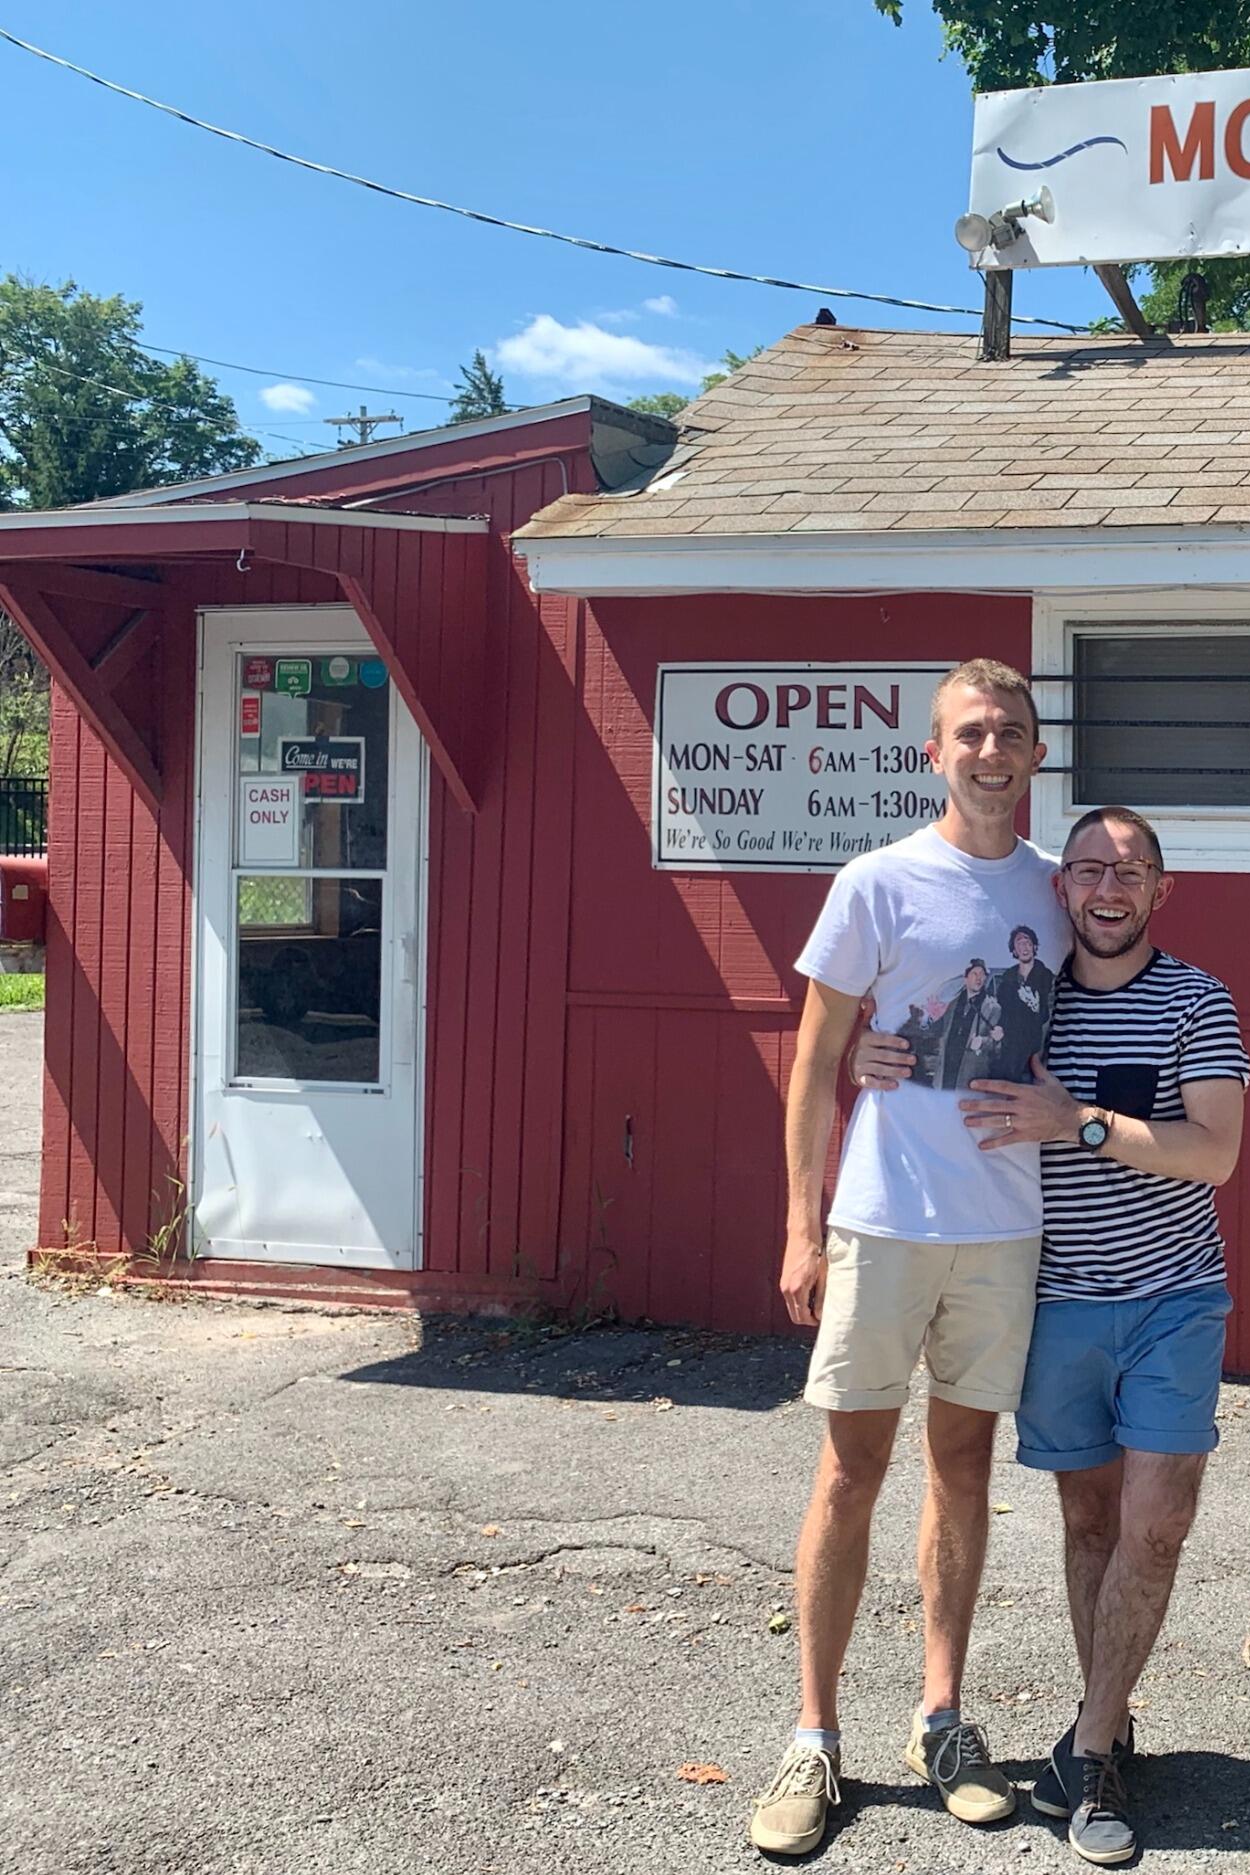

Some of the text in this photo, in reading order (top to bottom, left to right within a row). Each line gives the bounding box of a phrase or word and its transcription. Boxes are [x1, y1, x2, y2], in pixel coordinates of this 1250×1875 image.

[714, 681, 901, 730] OPEN
[284, 745, 359, 770] Come in WE'RE
[668, 742, 933, 774] MON-SAT 6AM-1:30P
[249, 788, 290, 803] CASH
[303, 773, 357, 796] PEN
[667, 786, 765, 816] SUNDAY
[249, 809, 290, 824] ONLY
[666, 828, 707, 849] We're
[712, 829, 732, 851] So
[737, 829, 776, 851] Good
[782, 830, 823, 852] We're
[829, 831, 873, 853] Worth
